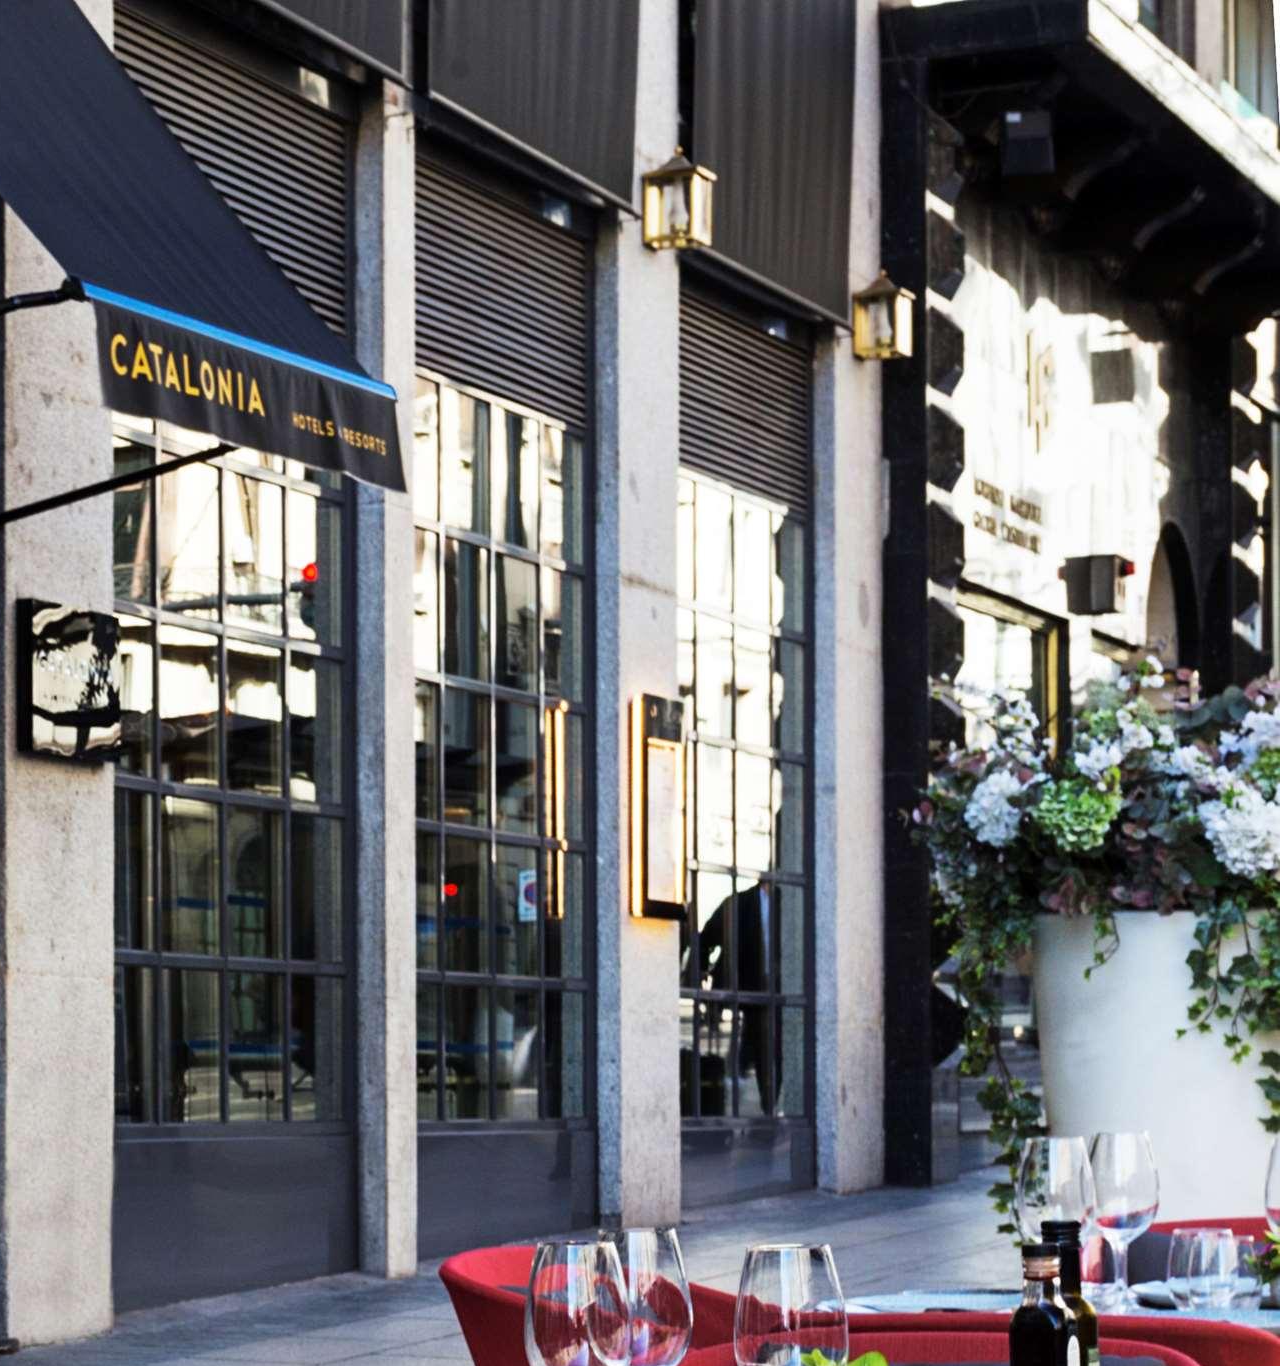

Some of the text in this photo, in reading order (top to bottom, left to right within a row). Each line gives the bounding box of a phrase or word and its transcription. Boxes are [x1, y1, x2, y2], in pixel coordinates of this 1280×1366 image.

[110, 333, 266, 417] CATALONIA
[291, 411, 335, 437] HOTELS
[342, 426, 387, 456] RESORTS
